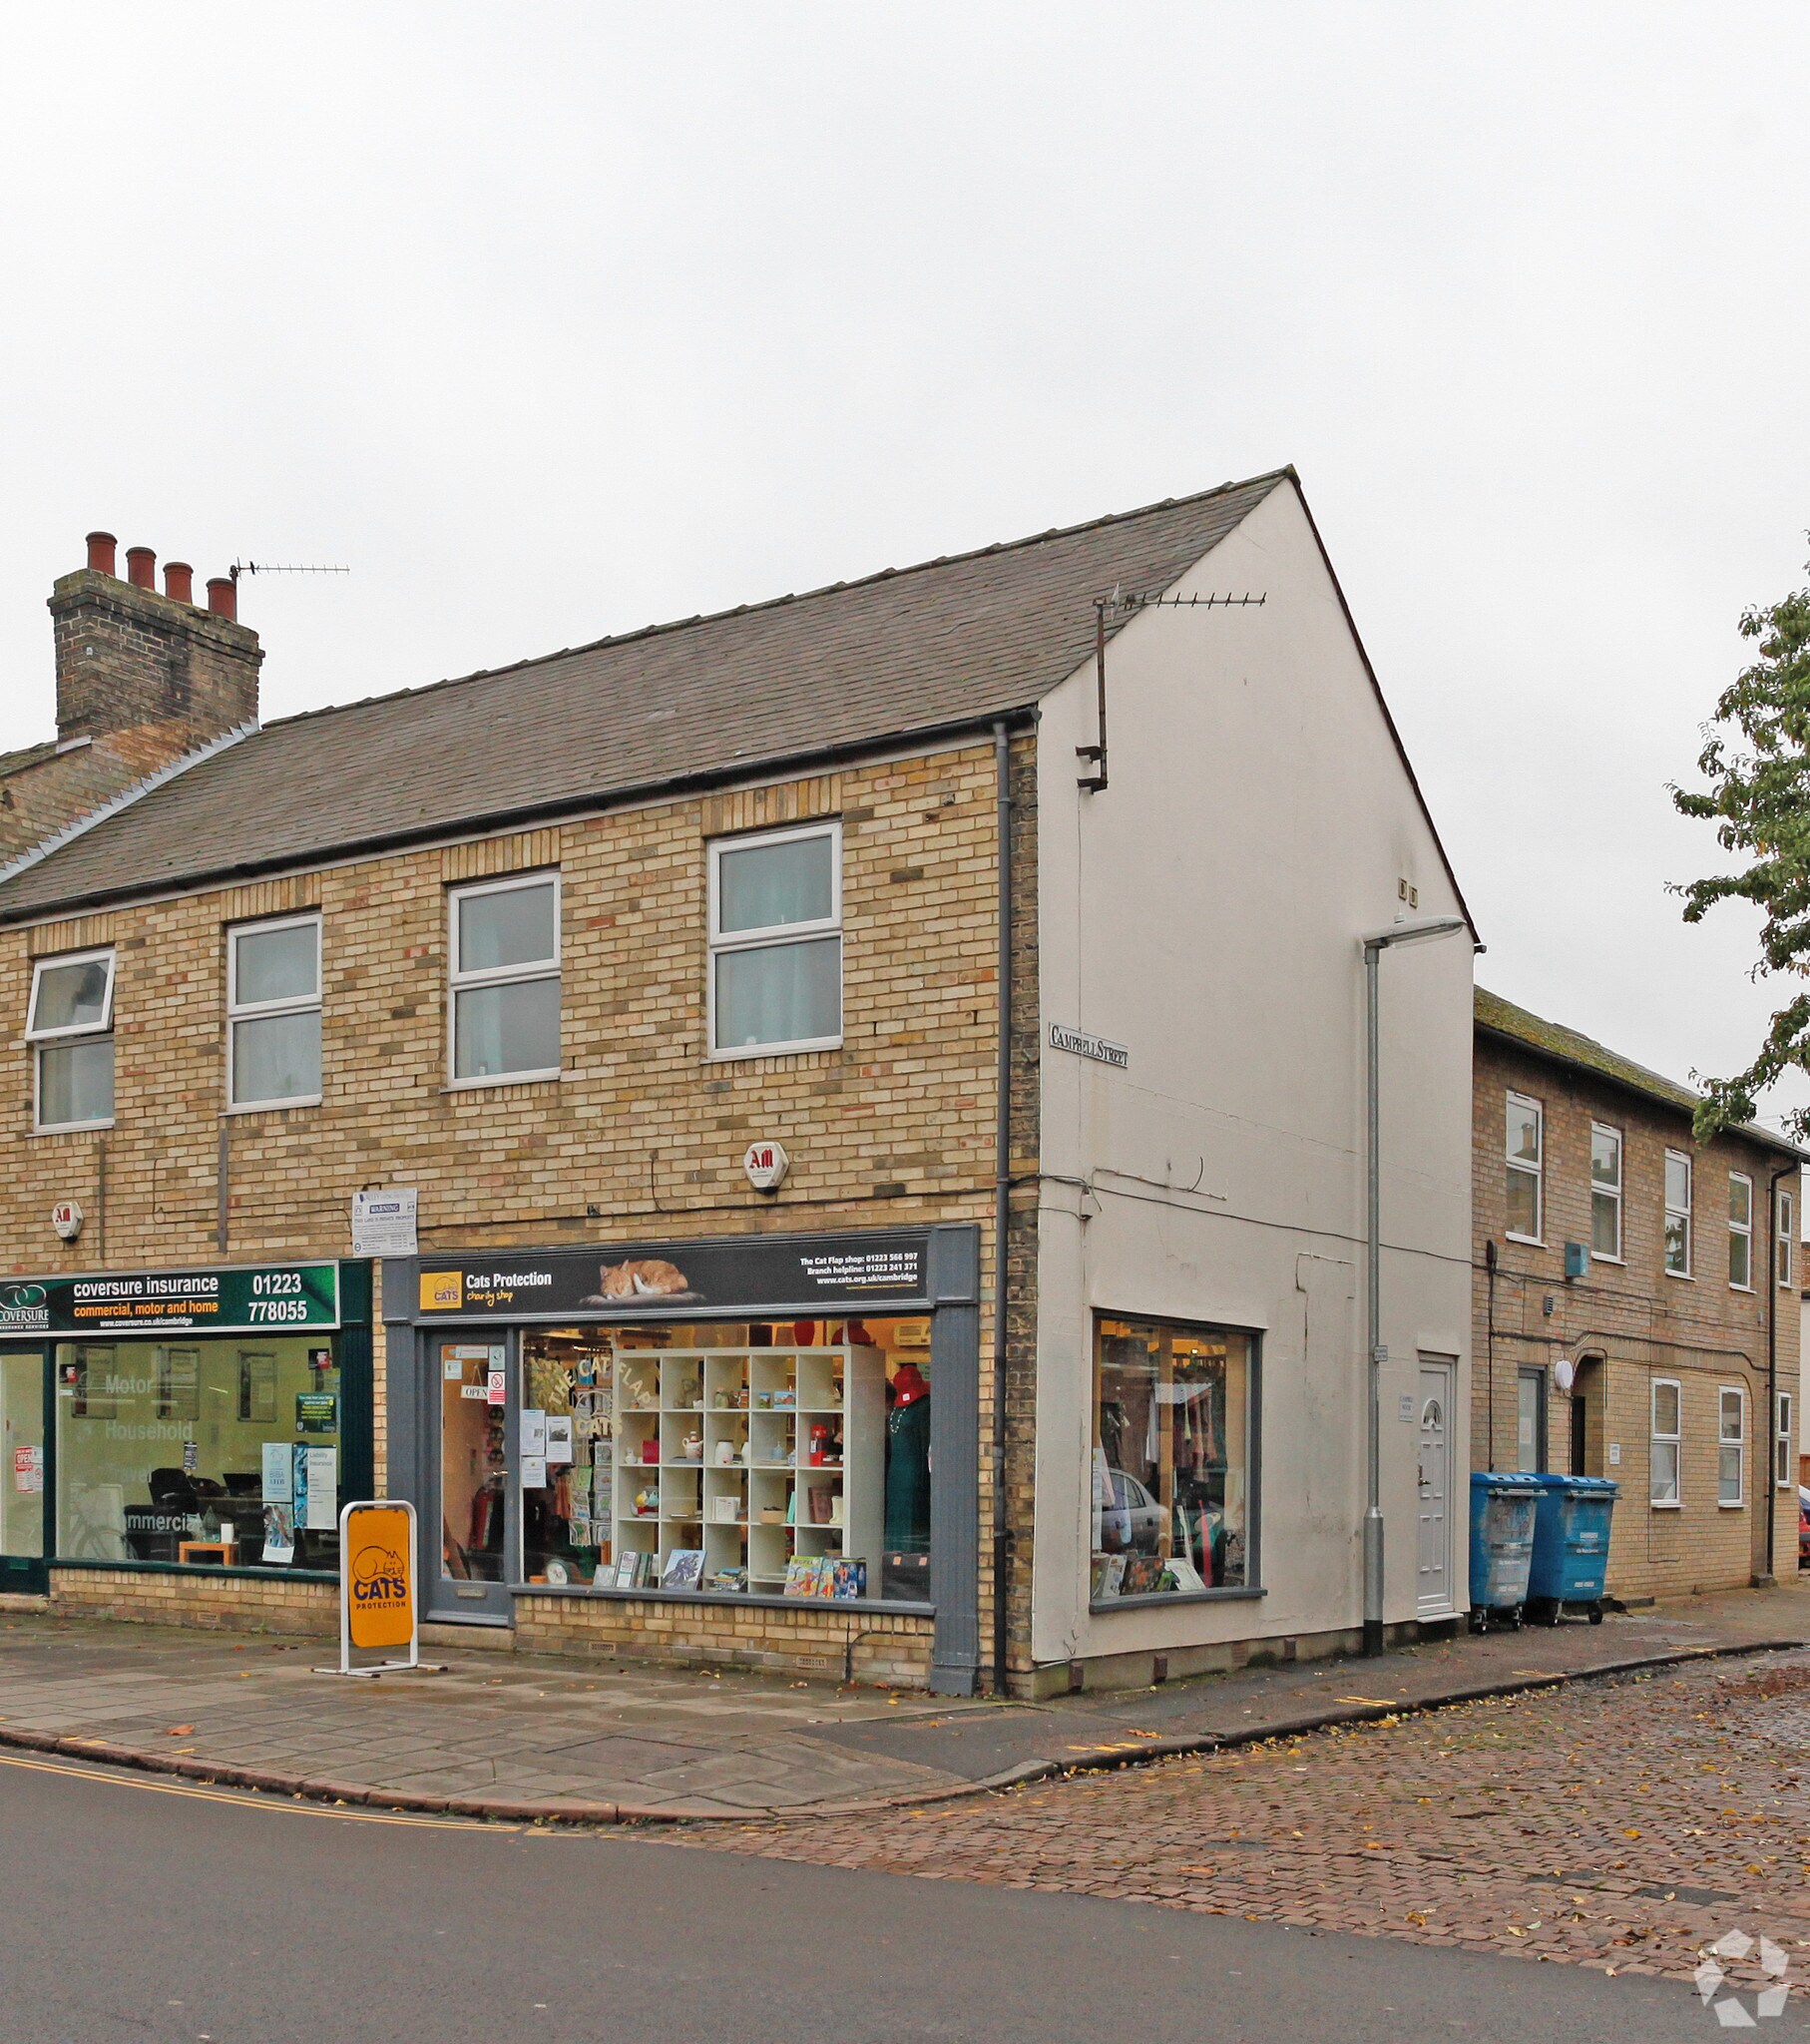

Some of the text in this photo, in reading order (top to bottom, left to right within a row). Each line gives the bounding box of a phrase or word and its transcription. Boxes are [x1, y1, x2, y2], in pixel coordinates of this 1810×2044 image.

[370, 1204, 399, 1213] WARNING
[815, 1257, 828, 1266] Cat
[845, 1256, 865, 1264] shop:
[866, 1254, 888, 1263] 01223
[889, 1253, 903, 1262] 566
[904, 1252, 918, 1261] 997
[807, 1262, 918, 1276] Branch helpline: 01223 241 371
[73, 1277, 219, 1297] coversure insurance
[252, 1273, 302, 1295] 01223
[466, 1271, 552, 1289] Cats Protection
[817, 1273, 918, 1284] www.cats.org.uk/cambridge
[434, 1289, 458, 1301] CATS
[466, 1289, 513, 1307] charity shop
[74, 1301, 219, 1318] commercial, motor and home
[248, 1300, 308, 1322] 778055
[105, 1374, 151, 1394] Motor
[549, 1356, 651, 1406] THE CAT FLAP
[465, 1387, 487, 1397] OPEN
[105, 1421, 193, 1441] Household
[576, 1413, 623, 1436] CATS
[354, 1577, 406, 1600] CATS
